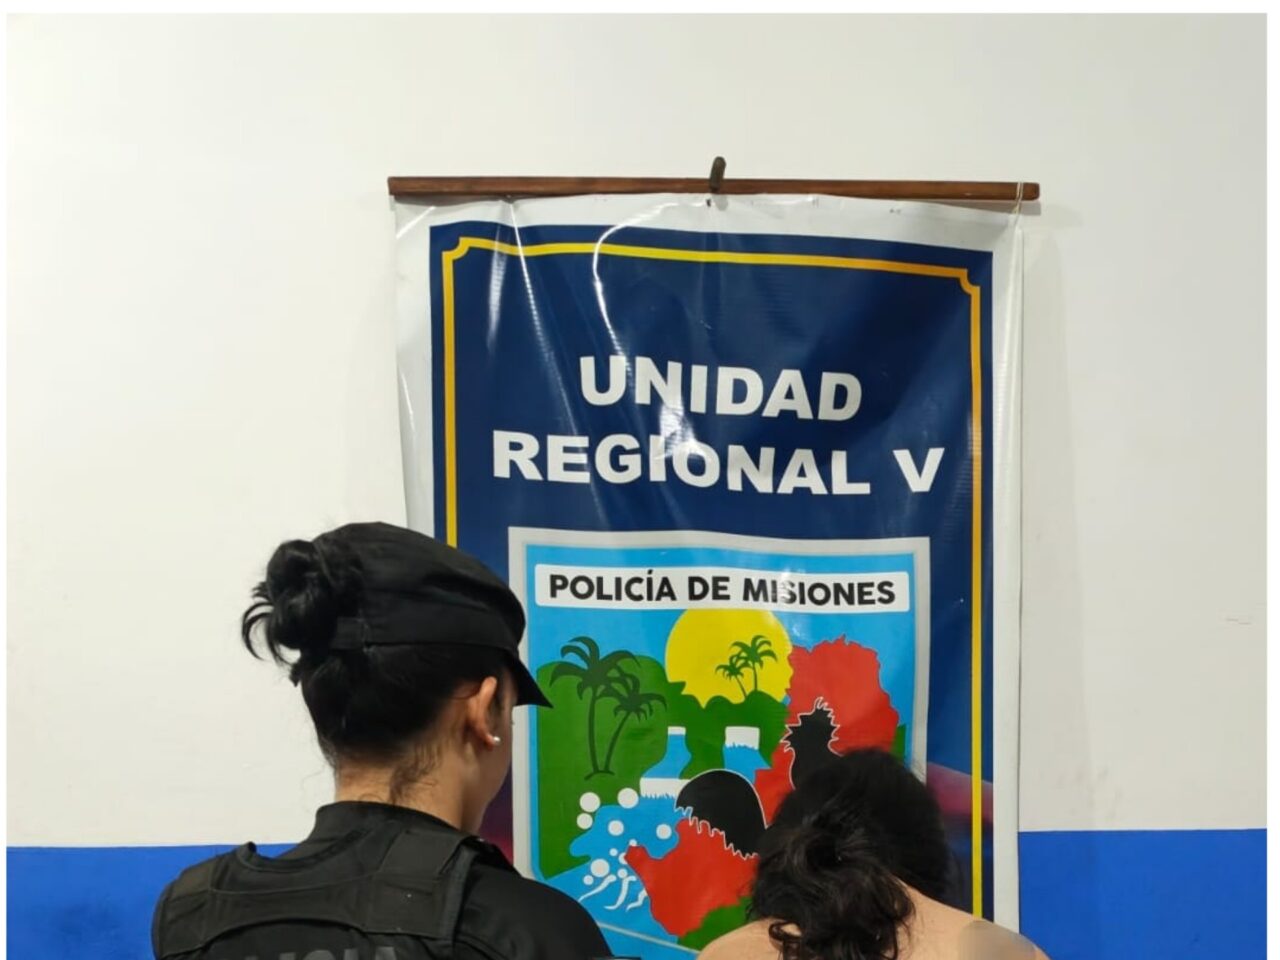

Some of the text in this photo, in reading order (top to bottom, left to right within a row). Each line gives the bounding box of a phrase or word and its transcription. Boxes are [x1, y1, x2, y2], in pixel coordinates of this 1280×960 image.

[579, 356, 862, 421] UNIDAD
[492, 429, 945, 495] REGIONAL V
[549, 569, 896, 606] POLICÍA DE MISIONES
